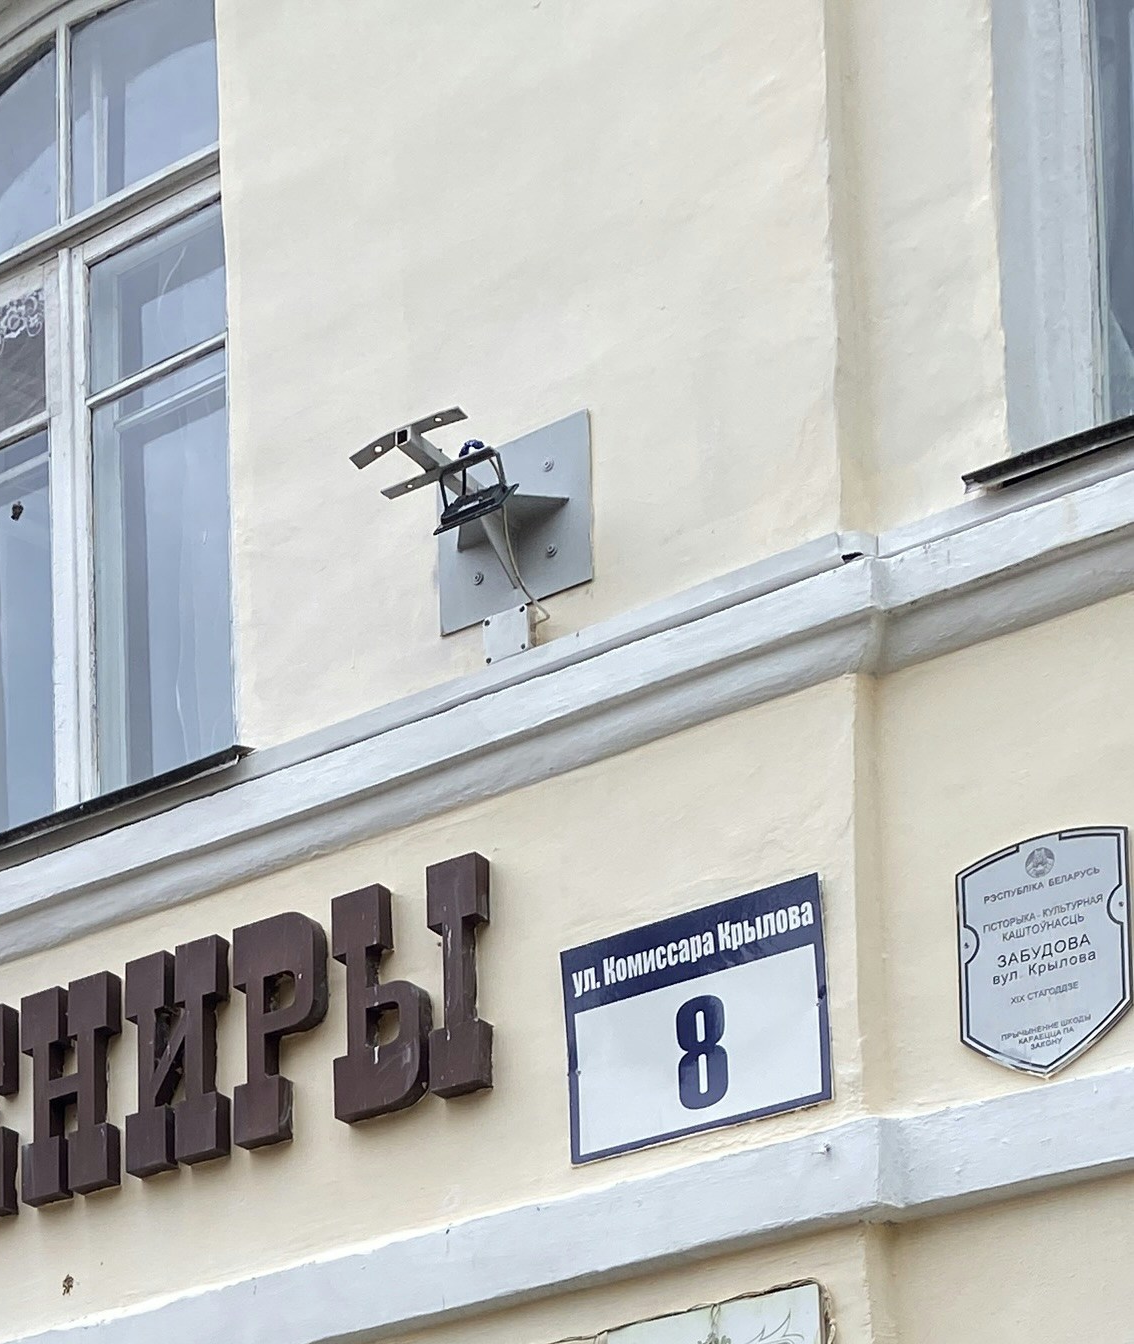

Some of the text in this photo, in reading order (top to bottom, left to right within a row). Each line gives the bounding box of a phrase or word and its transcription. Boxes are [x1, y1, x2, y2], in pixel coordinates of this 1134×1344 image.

[984, 867, 1100, 904] РЭСПУБЛІКА БЕЛАРУСЬ
[1002, 913, 1084, 941] КАШТОЎНАСЦЬ
[571, 899, 814, 998] ул. Комиссара Крылова
[997, 934, 1091, 968] ЗАБУДОВА
[1028, 951, 1096, 976] Крылова
[1027, 981, 1079, 1000] СТАГОДДЗЕ
[1001, 1014, 1091, 1041] ПРЫЧЫНЕННЕ ШКОДЫ
[1018, 1027, 1074, 1045] КАРАЕЦЦА ПА
[675, 994, 729, 1110] 8
[1030, 1038, 1063, 1050] ЗАКОНУ
